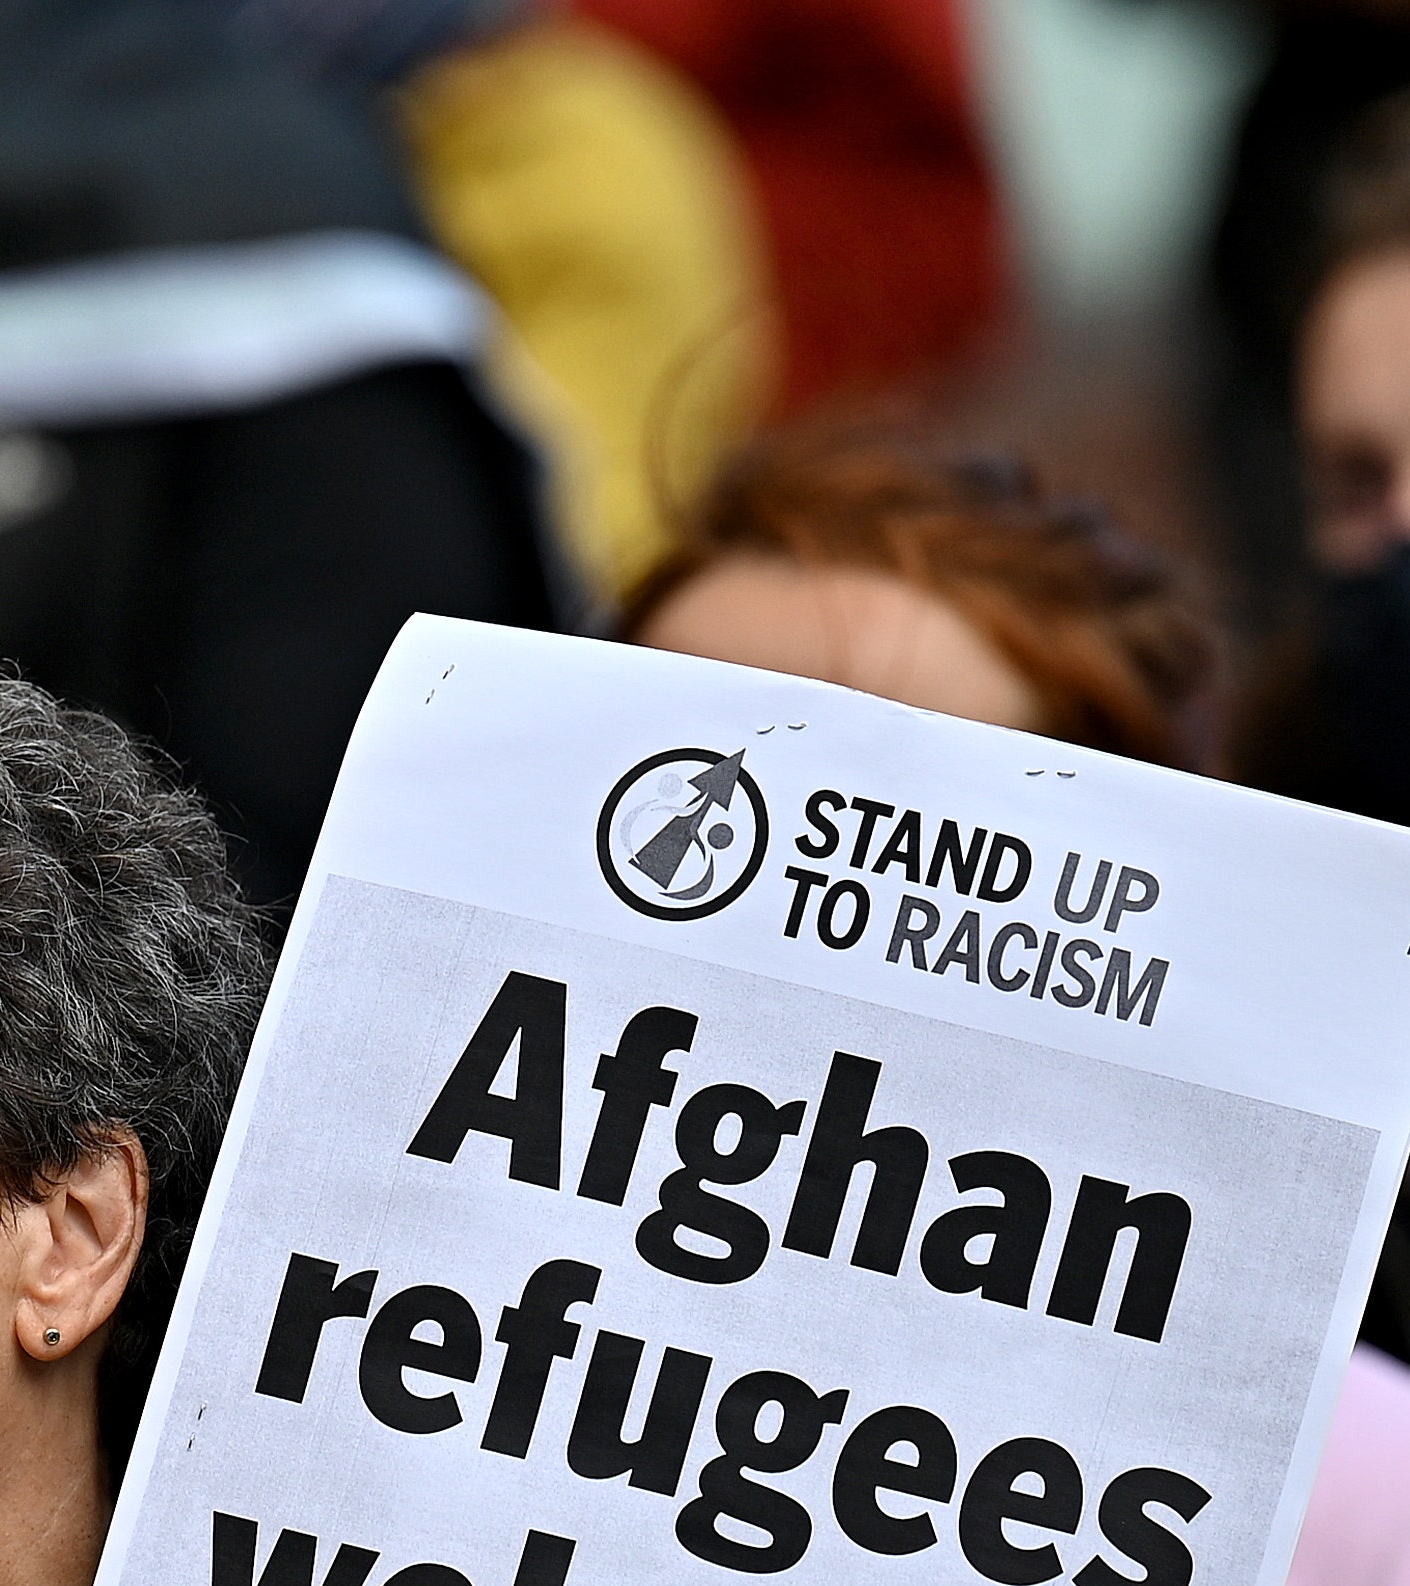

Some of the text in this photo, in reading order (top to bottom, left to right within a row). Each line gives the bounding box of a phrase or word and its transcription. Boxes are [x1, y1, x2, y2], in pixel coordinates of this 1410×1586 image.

[794, 788, 1161, 935] STAND UP
[783, 864, 1171, 1027] TO RACISM
[405, 969, 1193, 1345] Afghan
